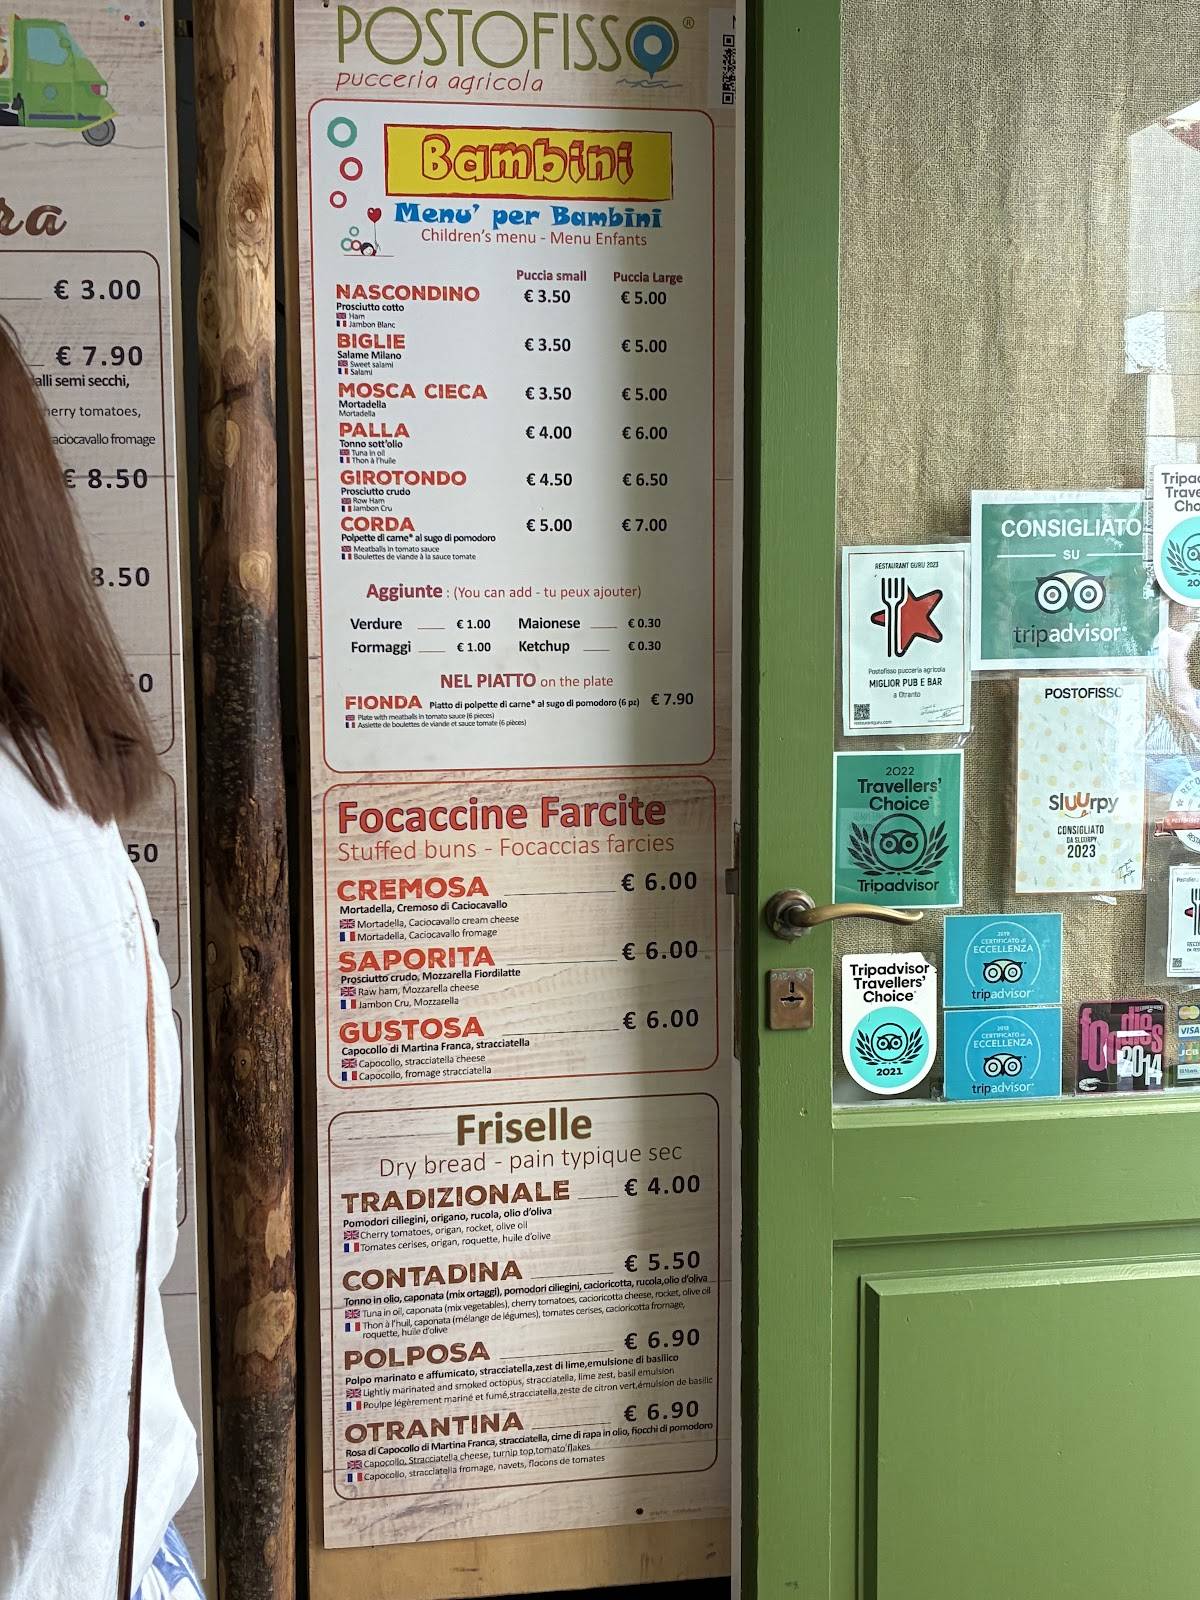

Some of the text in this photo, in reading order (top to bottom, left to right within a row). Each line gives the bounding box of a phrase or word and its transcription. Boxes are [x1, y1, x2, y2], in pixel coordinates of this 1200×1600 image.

[338, 6, 679, 72] POSTOFISSO
[336, 70, 543, 95] pucceria agricola
[421, 134, 633, 184] Bambini
[395, 203, 662, 230] Menu' per Bambini
[421, 228, 647, 246] Children's menu Menu Enfants
[517, 269, 586, 281] Puccia small
[614, 271, 683, 285] Puccia Large
[81, 279, 140, 300] 3.00
[336, 285, 479, 301] NASCONDINO
[538, 289, 570, 303] 3.50
[634, 291, 667, 304] 5.00
[337, 303, 404, 311] Prosciutto cotto
[349, 320, 395, 329] Jambon Blanc
[338, 334, 405, 349] BIGLIE
[82, 346, 142, 366] 7.90
[338, 351, 401, 360] Salame Milano
[55, 375, 85, 386] semi
[88, 375, 129, 388] secchi,
[339, 383, 487, 399] MOSCA CIECA
[80, 406, 141, 417] tomatoes,
[339, 400, 387, 409] Mortadella
[339, 422, 409, 438] PALLA
[52, 434, 155, 446] aciocavallo fromage
[340, 440, 365, 449] Tonno
[88, 469, 147, 488] 8.50
[340, 470, 466, 486] GIROTONDO
[341, 487, 410, 496] Prosciutto crudo
[341, 517, 414, 532] CORDA
[1001, 519, 1141, 537] CONSIGLIATO
[1063, 550, 1080, 560] SU
[366, 583, 442, 601] Aggiunte
[351, 618, 402, 629] Verdure
[518, 617, 580, 629] Maionese
[1013, 624, 1120, 647] tripadvisor
[351, 641, 411, 655] Formaggi
[519, 640, 570, 654] Ketchup
[441, 673, 613, 689] NEL PIATTO on the plate
[870, 679, 900, 688] MIGLIOR
[928, 678, 942, 686] BAR
[345, 696, 422, 710] FIONDA
[886, 767, 914, 775] 2022
[858, 778, 941, 793] Travellers'
[870, 797, 929, 810] Choice
[339, 794, 666, 834] Focaccine Farcite
[1058, 825, 1104, 835] CONSIGLIATO
[339, 834, 674, 862] Stuffed buns Focaccias farcies
[1068, 844, 1096, 858] 2023
[337, 877, 489, 901] CREMOSA
[645, 872, 697, 891] 6.00
[857, 879, 939, 893] Tripadvisor
[340, 900, 507, 915] Mortadella, Cremoso di Caciocavallo
[973, 945, 1033, 954] ECCELLENZA
[339, 946, 495, 972] SAPORITA
[341, 967, 521, 984] Prosciutto crudo, Mozzarella Fiordilatte
[850, 963, 929, 978] Tripadvisor
[358, 983, 479, 996] Raw ham, Mozzarella cheese
[854, 976, 926, 990] Travellers'
[863, 991, 914, 1003] Choice
[972, 989, 1031, 1001] tripadvisor
[339, 1017, 484, 1044] GUSTOSA
[973, 1039, 1033, 1049] ECCELLENZA
[877, 1068, 903, 1076] 2021
[1122, 1045, 1162, 1085] 2014
[973, 1082, 1031, 1095] tripadvisor
[457, 1108, 592, 1146] Friselle
[380, 1145, 682, 1179] Dry bread pain typique sec
[648, 1175, 700, 1195] 4.00
[342, 1180, 569, 1214] TRADIZIONALE
[343, 1217, 389, 1228] Pomodori
[392, 1214, 428, 1225] ciliegini,
[430, 1212, 468, 1222] origano,
[470, 1210, 501, 1220] rucola,
[504, 1208, 520, 1218] olio
[342, 1260, 522, 1291] CONTADINA
[344, 1341, 490, 1370] POLPOSA
[345, 1375, 372, 1385] Polpo
[375, 1372, 416, 1383] marinato
[426, 1368, 477, 1380] affumicato,
[345, 1412, 524, 1444] OTRANTINA
